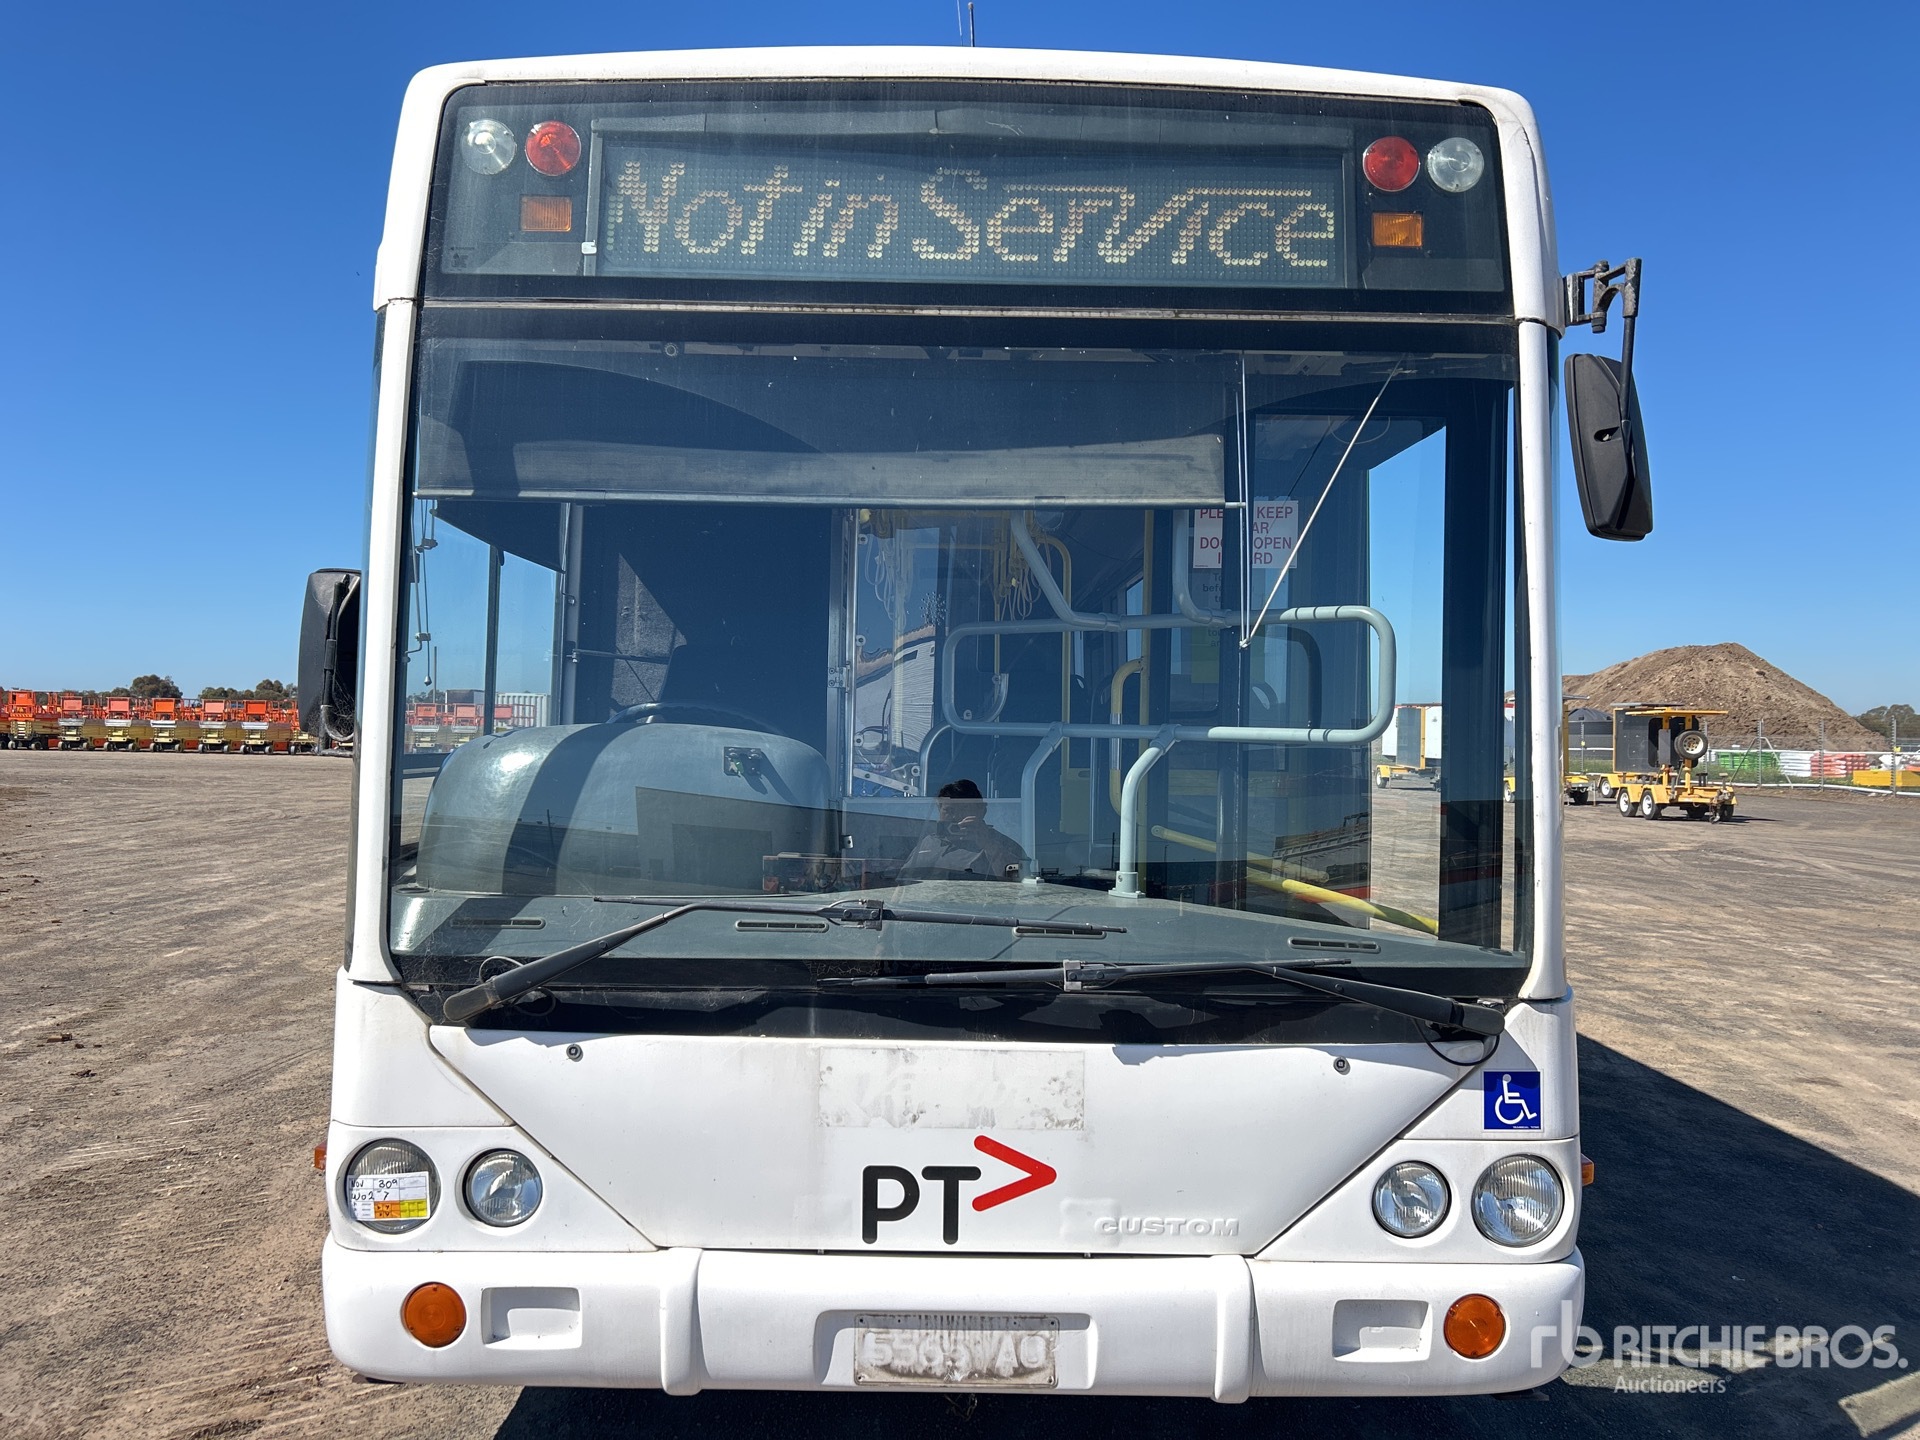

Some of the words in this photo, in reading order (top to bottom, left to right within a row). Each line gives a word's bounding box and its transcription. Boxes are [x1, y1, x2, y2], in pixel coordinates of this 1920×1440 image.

[607, 160, 802, 255] Not
[793, 174, 899, 258] in
[912, 167, 1335, 266] Service
[1257, 506, 1293, 519] KEEP
[1254, 536, 1292, 549] OPEN
[1095, 1217, 1240, 1237] CUSTOM
